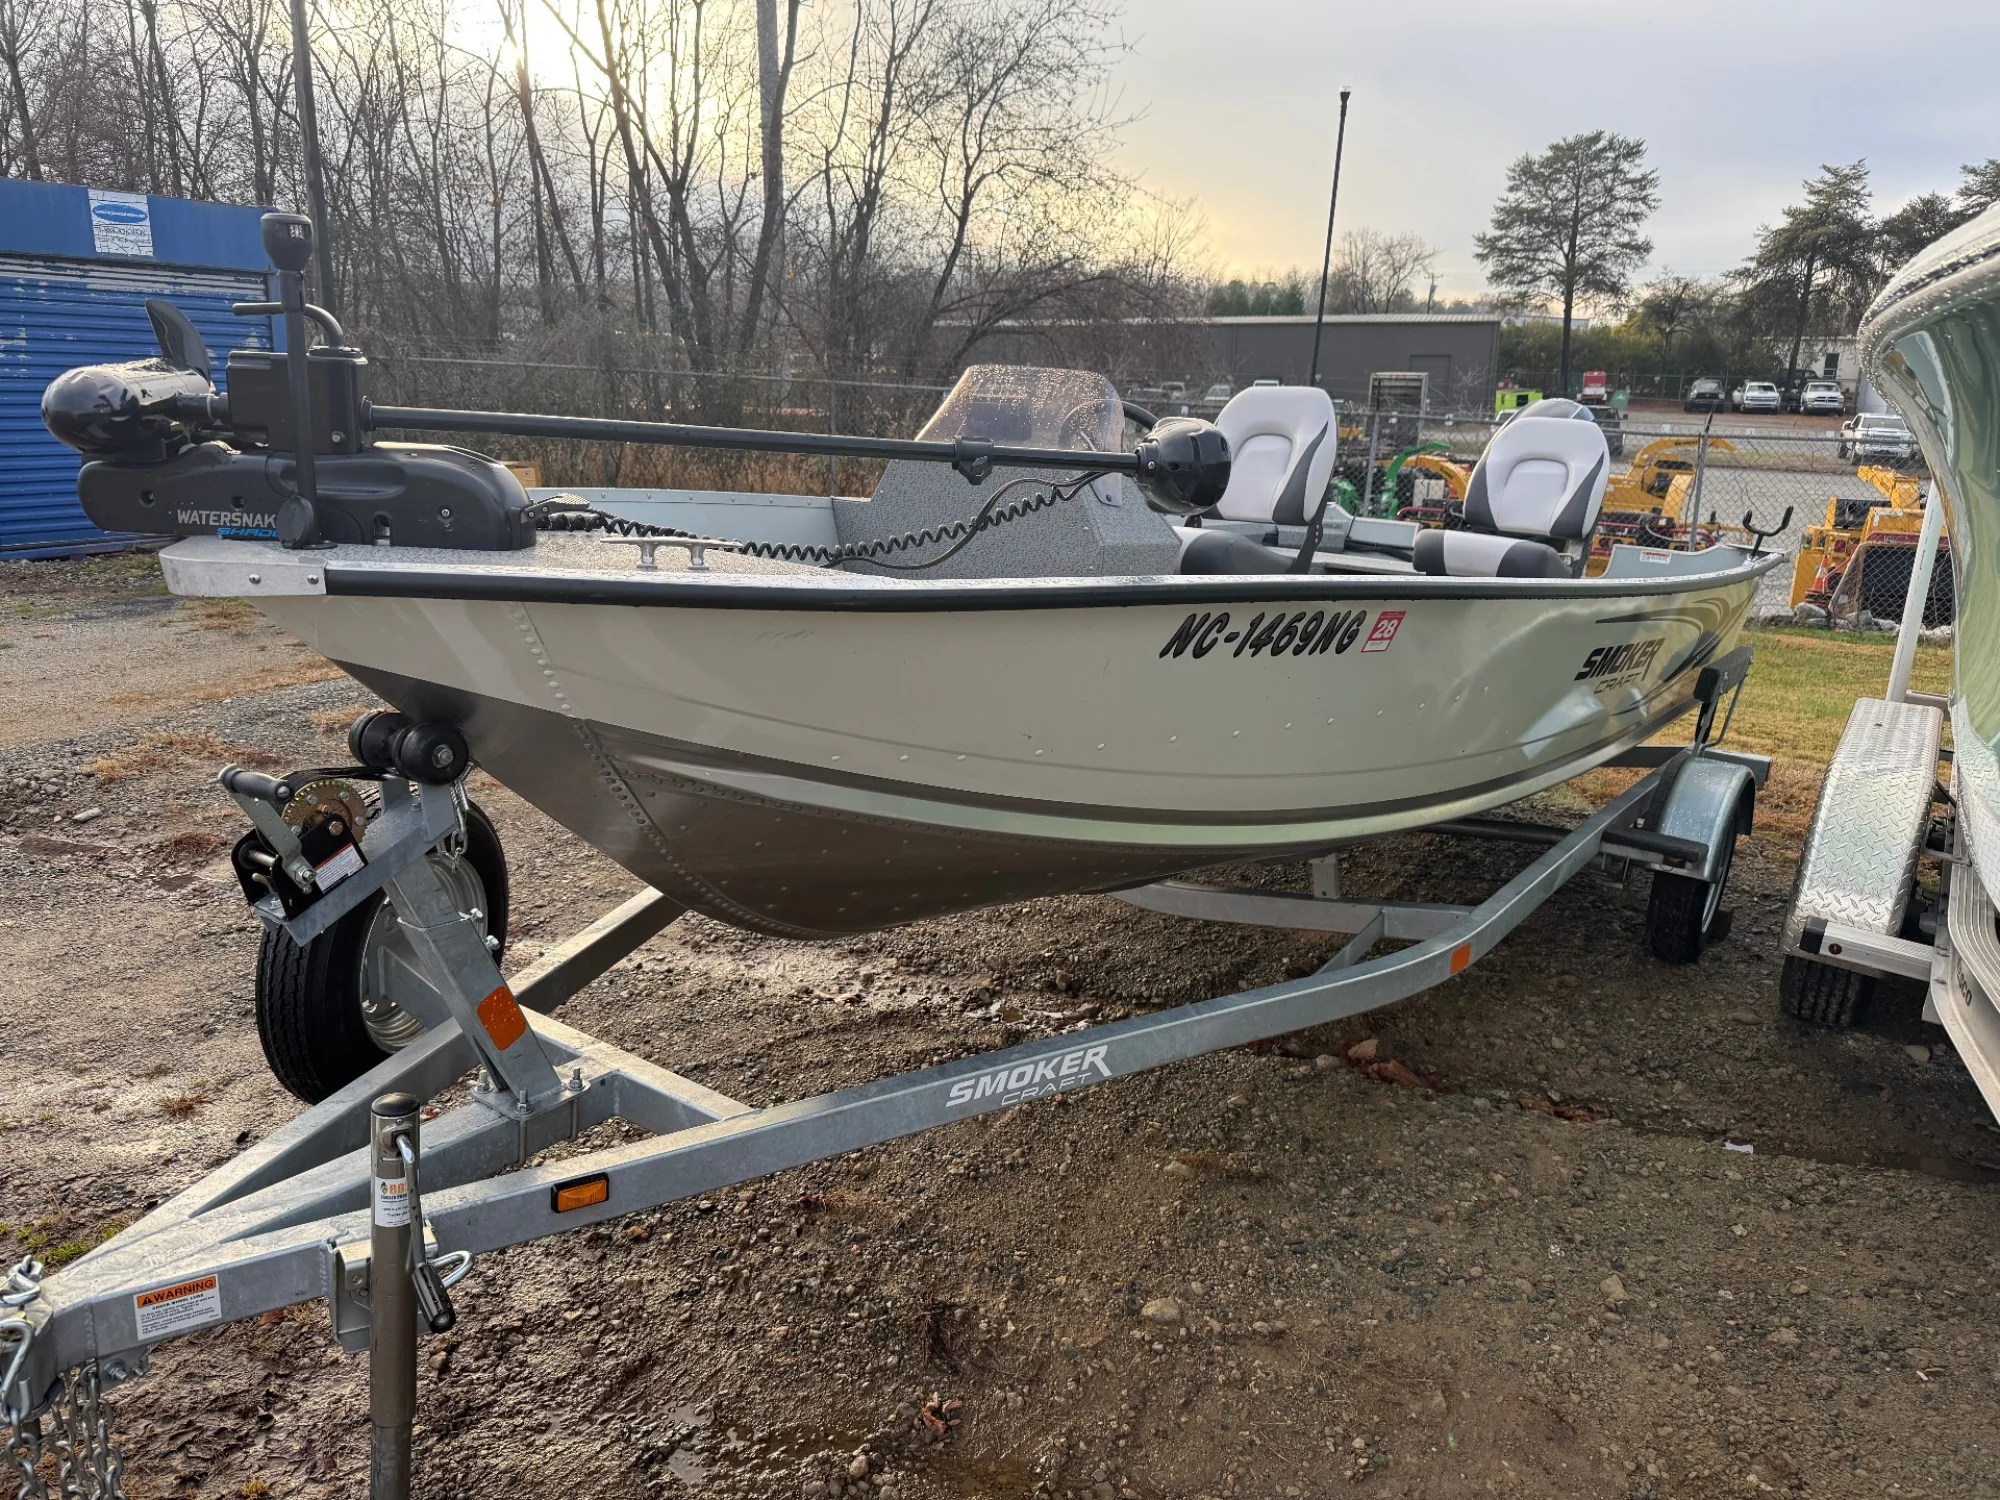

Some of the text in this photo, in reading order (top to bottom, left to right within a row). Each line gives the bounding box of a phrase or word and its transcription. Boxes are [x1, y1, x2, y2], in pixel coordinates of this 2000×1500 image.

[177, 509, 277, 528] WATERSNAK
[1159, 610, 1367, 659] NC-1469NG
[1371, 619, 1399, 639] 28
[1573, 637, 1666, 682] SMOKER
[1593, 672, 1642, 694] CRAFT
[945, 1044, 1113, 1108] SMOKER
[1001, 1072, 1092, 1106] CRAFT
[153, 1279, 214, 1302] WARNING
